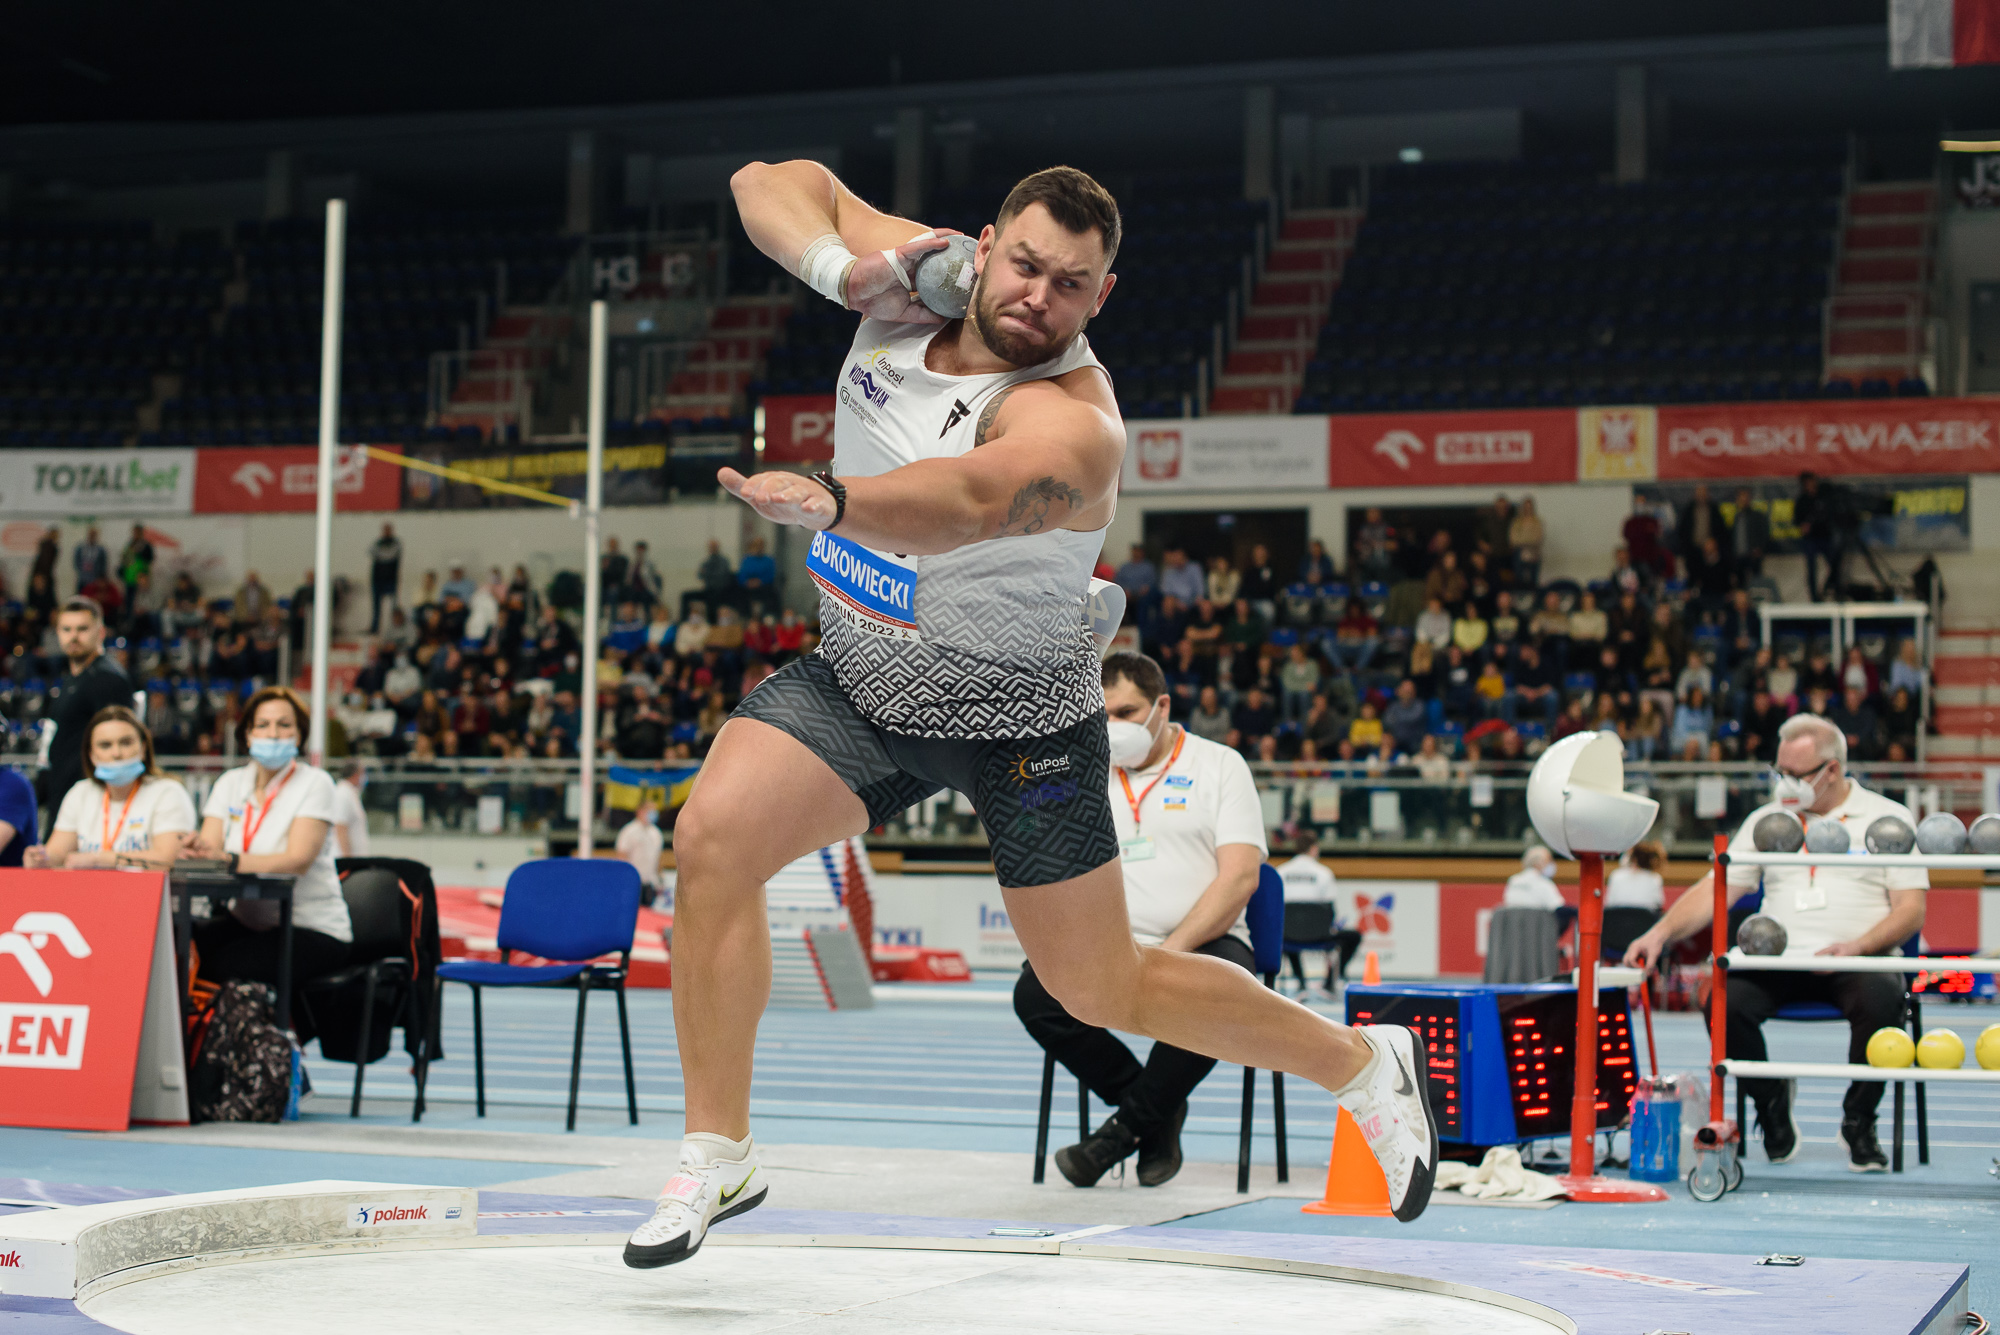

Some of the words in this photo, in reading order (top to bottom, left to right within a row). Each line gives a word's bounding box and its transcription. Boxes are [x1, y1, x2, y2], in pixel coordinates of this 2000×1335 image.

[877, 357, 905, 385] InPost
[1441, 436, 1527, 460] ORLEN
[1668, 426, 1805, 457] POLSKI
[811, 530, 909, 610] BUKOWIECKI
[859, 618, 896, 637] 2022
[1031, 754, 1070, 772] InPost
[0, 1015, 73, 1057] EN
[373, 1205, 428, 1225] polanik
